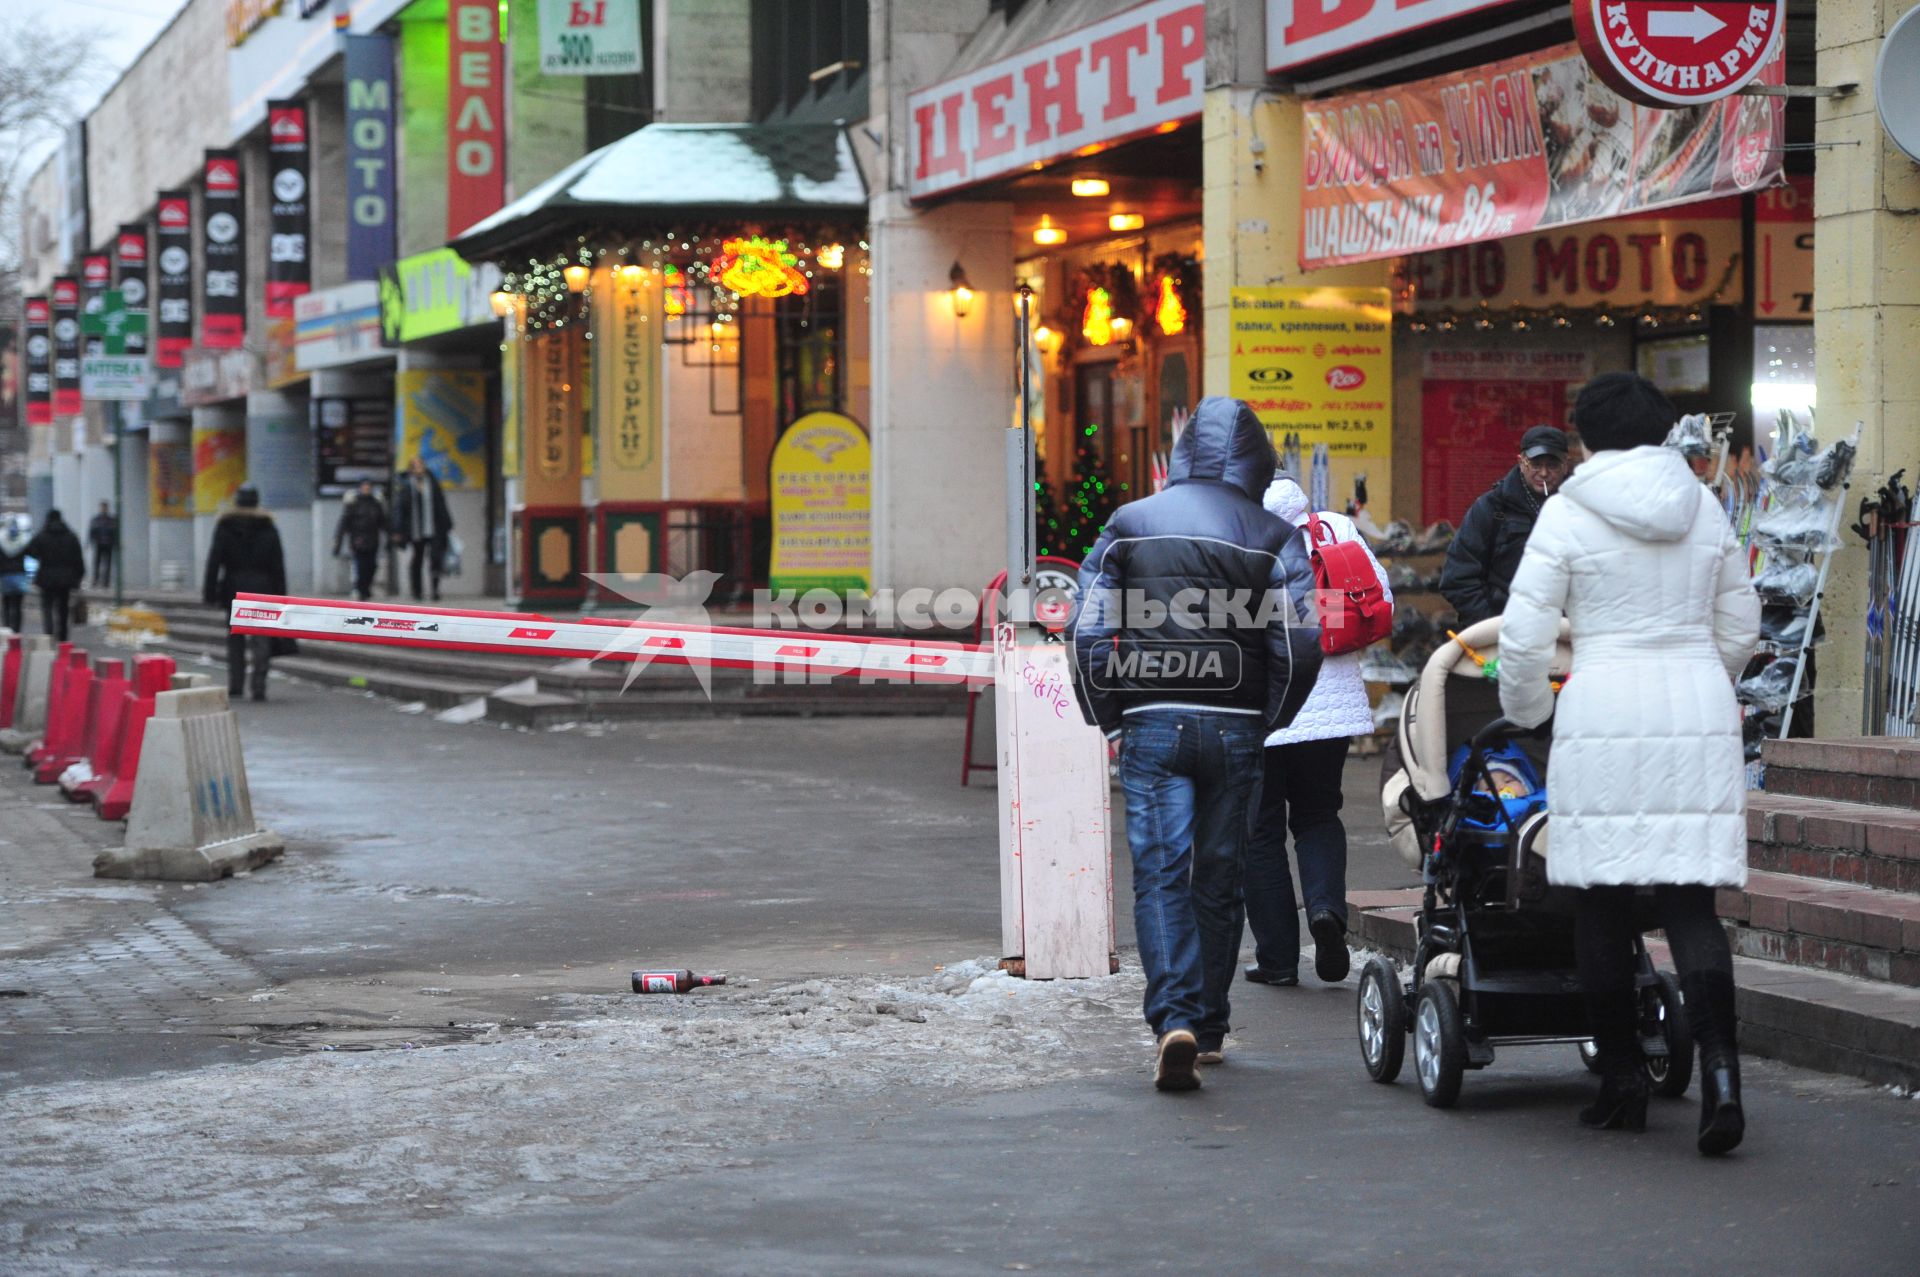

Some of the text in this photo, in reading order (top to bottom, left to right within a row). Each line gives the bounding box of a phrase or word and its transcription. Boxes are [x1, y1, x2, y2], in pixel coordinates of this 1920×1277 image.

[456, 6, 494, 176] ВЕЛО
[560, 33, 593, 65] 300
[914, 4, 1204, 180] ЦЕНТР
[1606, 2, 1769, 89] КУЛИНАРИЯ
[349, 79, 389, 226] МОТО
[1304, 99, 1413, 191] БЛЮДА
[1440, 69, 1542, 173] УГЛЯХ
[1304, 193, 1445, 261] ШАШЛЫКИ
[1455, 181, 1496, 240] 86
[1532, 232, 1708, 296] МОТО
